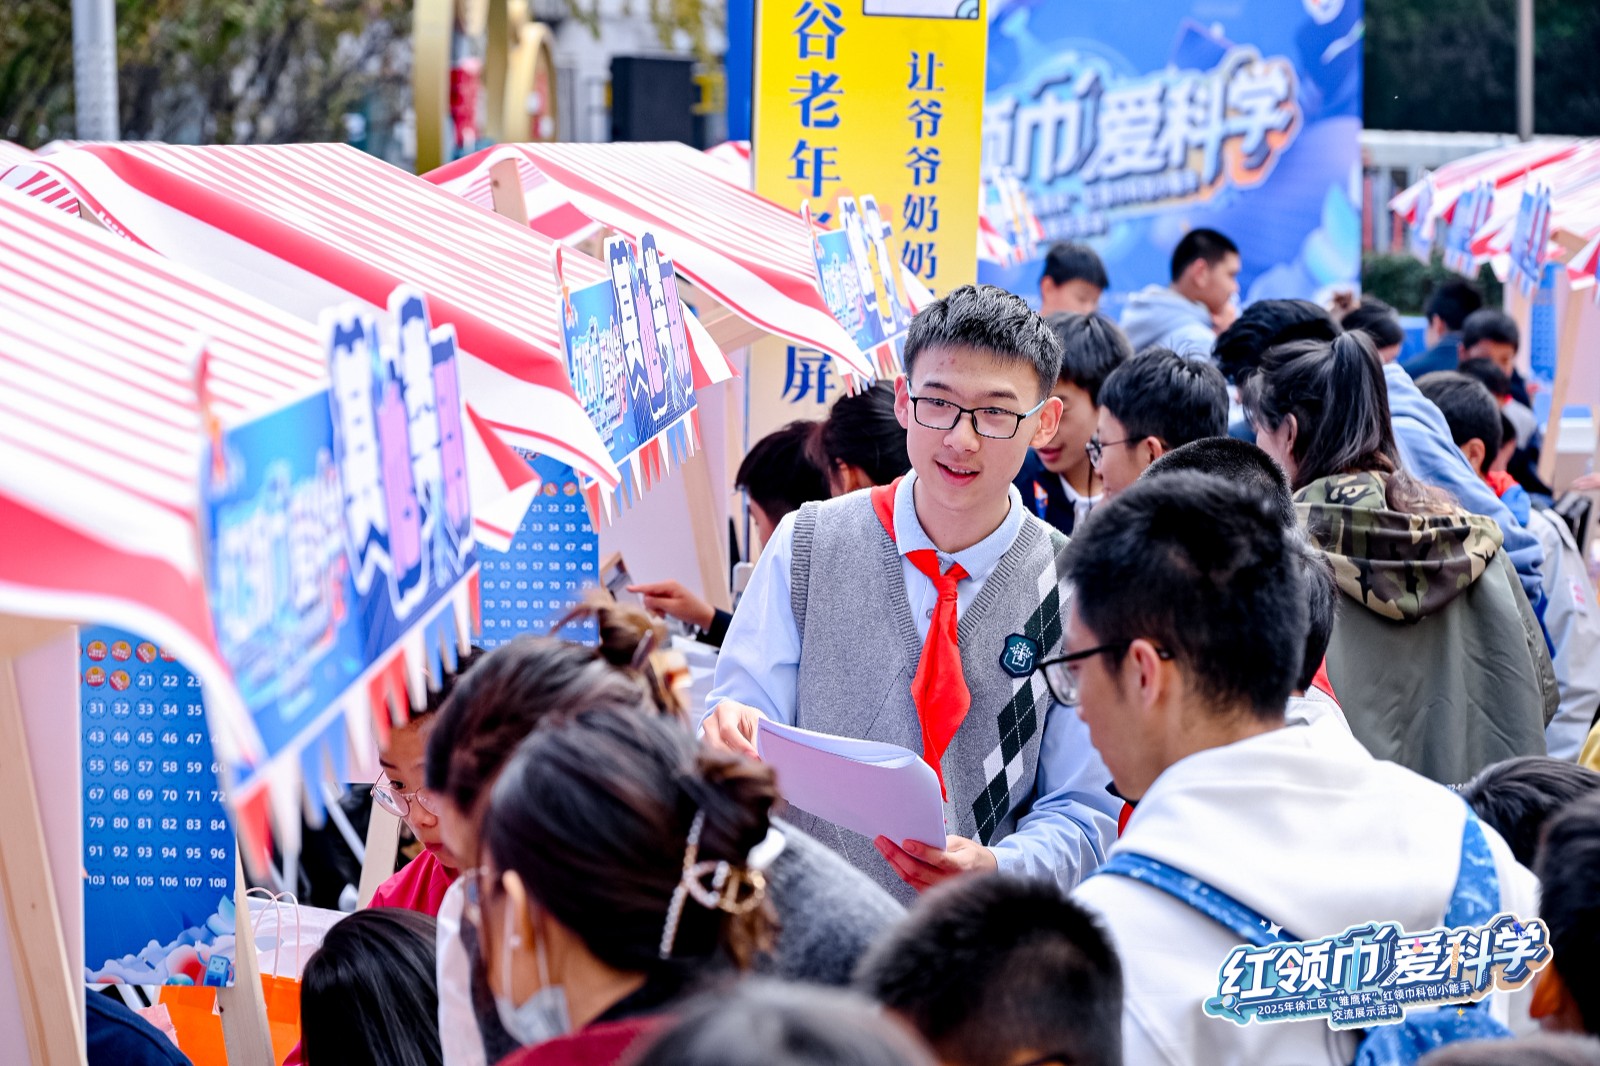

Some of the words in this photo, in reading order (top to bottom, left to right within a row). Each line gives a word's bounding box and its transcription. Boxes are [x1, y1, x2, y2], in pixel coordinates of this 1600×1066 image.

[900, 51, 945, 296] 让爷爷奶奶
[138, 674, 153, 687] 21
[162, 674, 178, 687] 22
[187, 676, 201, 687] 23
[89, 702, 104, 714] 31
[114, 702, 129, 715] 32
[138, 703, 154, 715] 33
[162, 703, 178, 716] 34
[187, 704, 202, 716] 35
[89, 731, 105, 743] 43
[113, 731, 129, 743] 44
[137, 732, 154, 744] 45
[161, 732, 178, 744] 46
[186, 733, 202, 745] 47
[89, 759, 105, 772] 55
[113, 759, 130, 772] 56
[138, 760, 154, 772] 57
[162, 761, 178, 773] 58
[186, 761, 203, 773] 59
[88, 788, 105, 800] 67
[113, 788, 129, 801] 68
[137, 789, 154, 801] 69
[162, 789, 178, 801] 70
[186, 790, 201, 802] 71
[210, 790, 226, 802] 72
[89, 816, 105, 828] 79
[113, 817, 129, 829] 80
[137, 817, 152, 829] 81
[161, 818, 177, 830] 82
[186, 818, 202, 831] 83
[210, 819, 226, 831] 84
[88, 845, 103, 857] 91
[113, 845, 129, 858] 92
[137, 846, 153, 858] 93
[161, 846, 177, 858] 94
[185, 847, 202, 859] 95
[210, 847, 226, 860] 96
[87, 875, 105, 886] 103
[111, 875, 130, 886] 104
[135, 876, 154, 887] 105
[159, 876, 179, 887] 106
[184, 877, 203, 887] 107
[208, 877, 227, 888] 108
